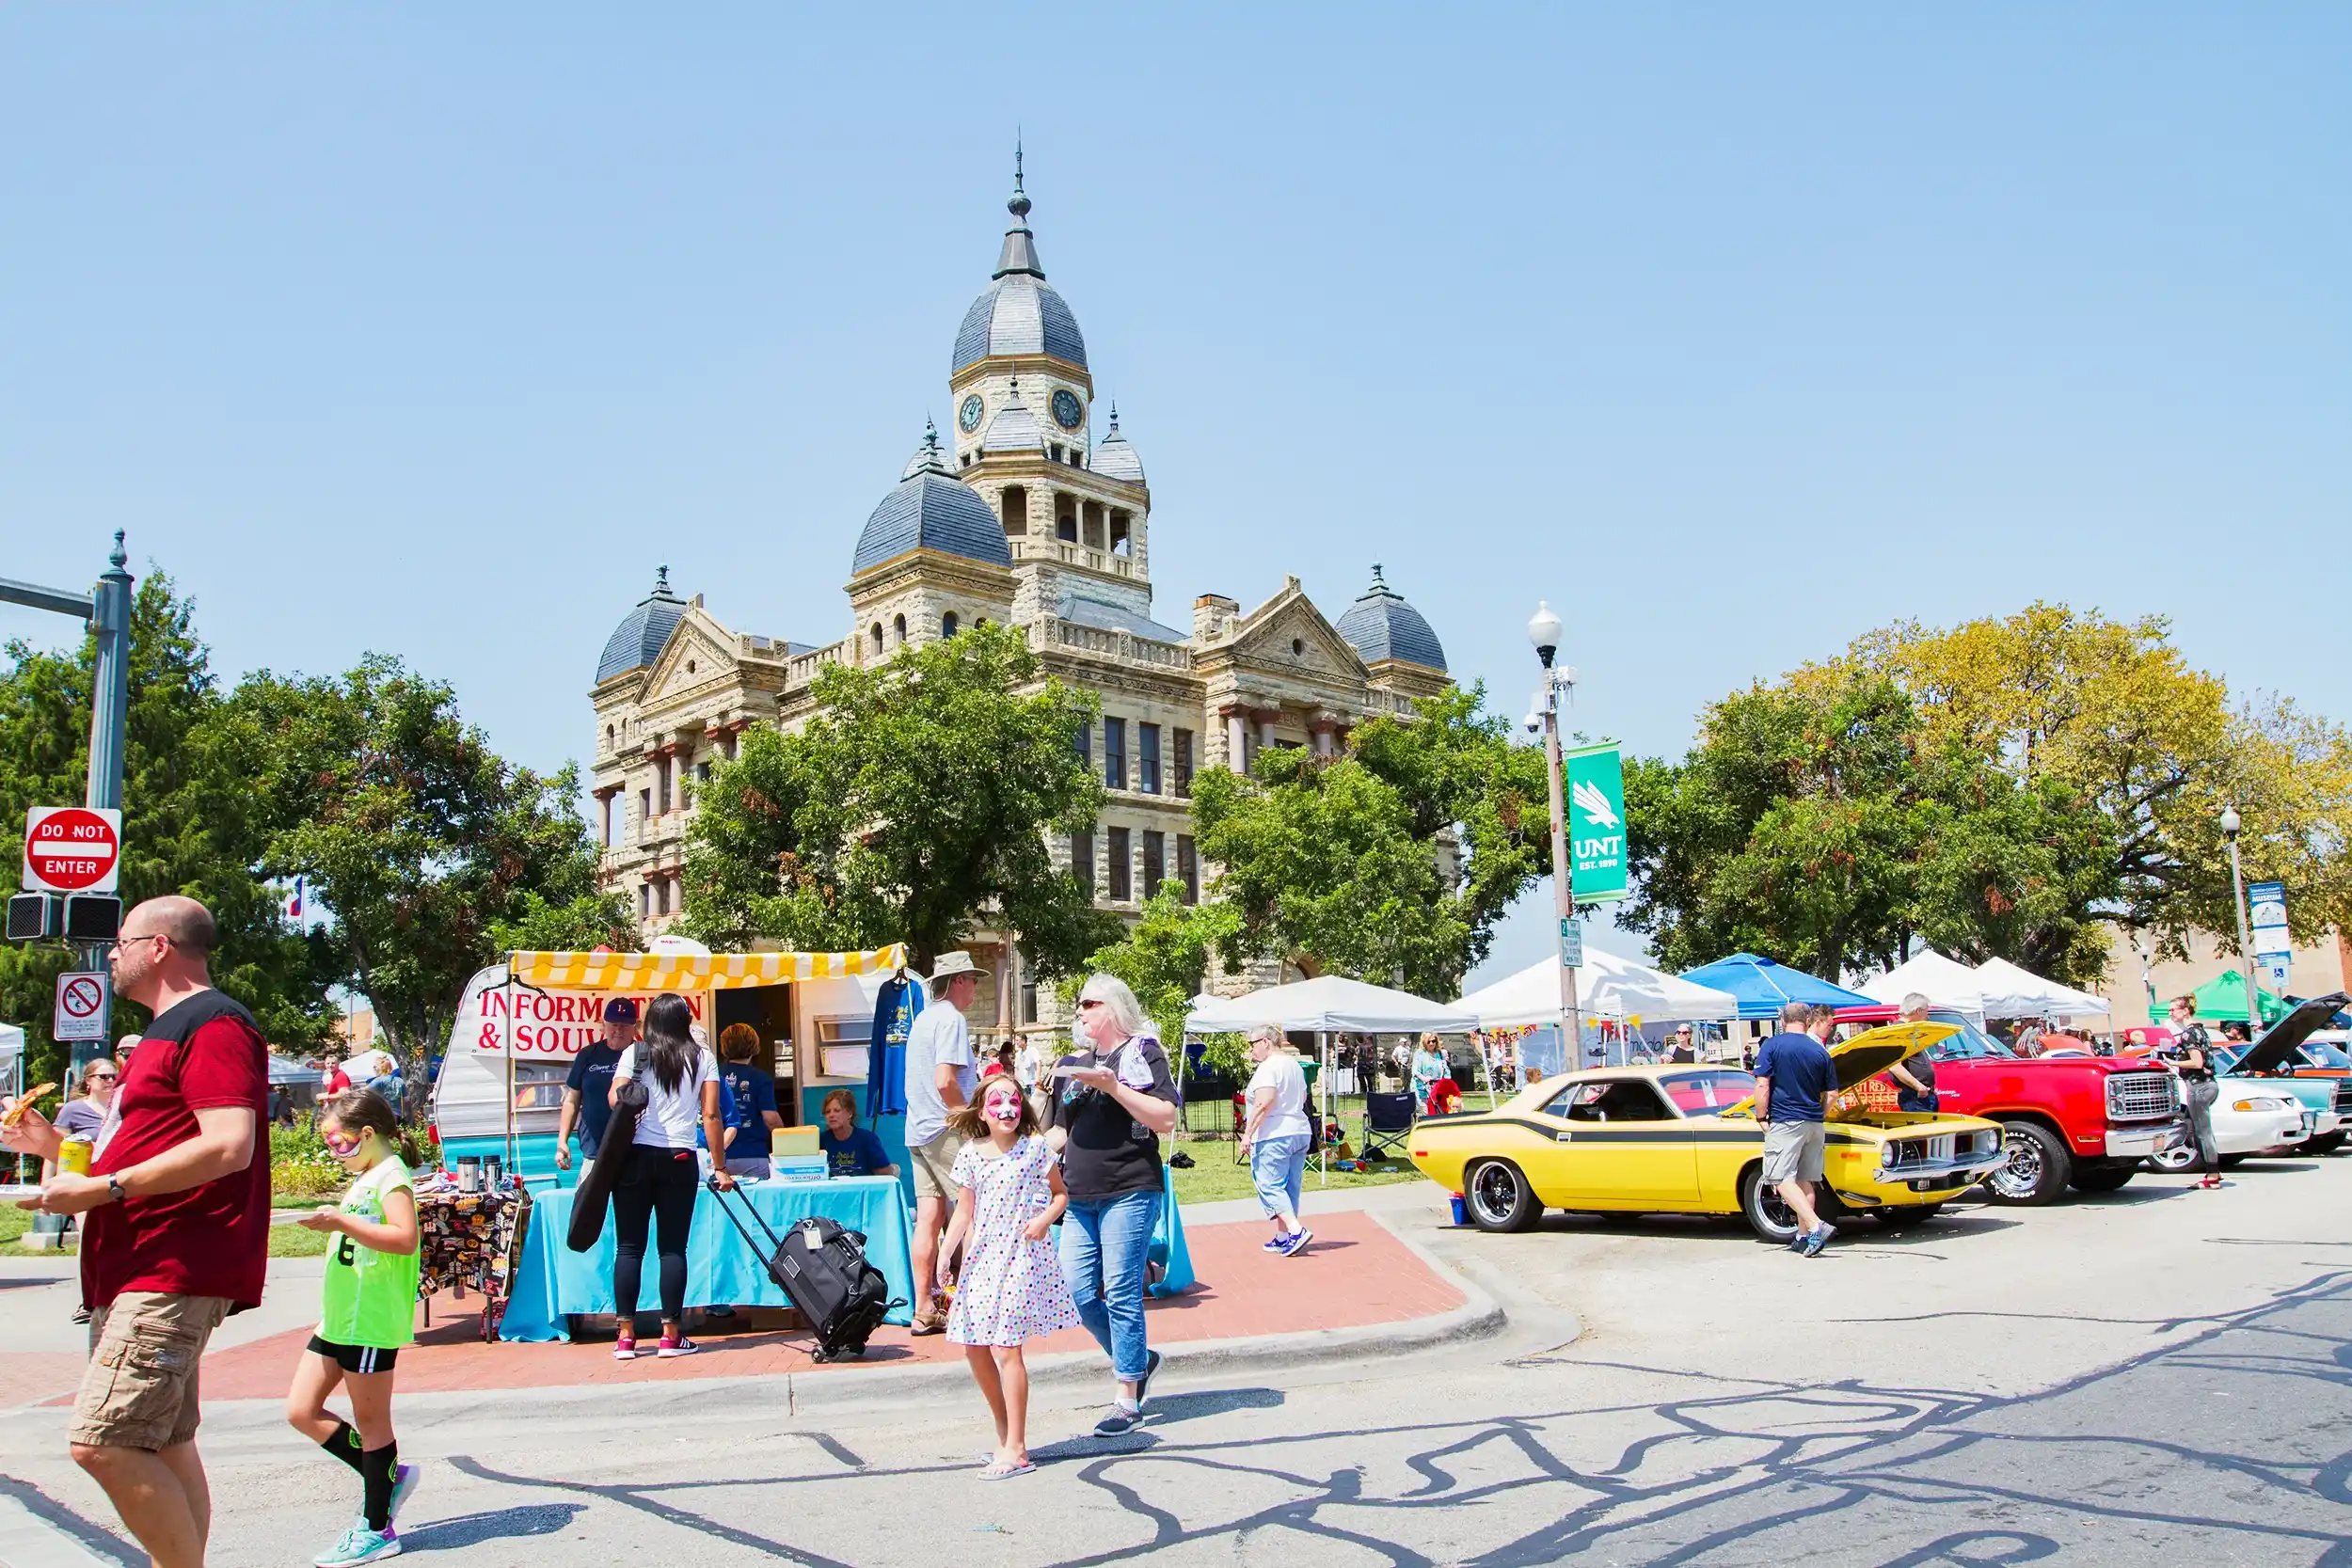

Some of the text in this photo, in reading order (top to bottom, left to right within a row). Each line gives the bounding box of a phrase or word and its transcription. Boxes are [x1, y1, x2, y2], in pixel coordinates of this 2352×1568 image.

[41, 824, 105, 838] DO NOT
[1573, 835, 1623, 859] UNT
[45, 860, 97, 874] ENTER
[1579, 861, 1597, 870] EST.
[2251, 894, 2282, 903] MUSEUM
[480, 990, 702, 1024] INFORMTN
[478, 1022, 501, 1050] &
[1868, 1081, 1886, 1092] RED
